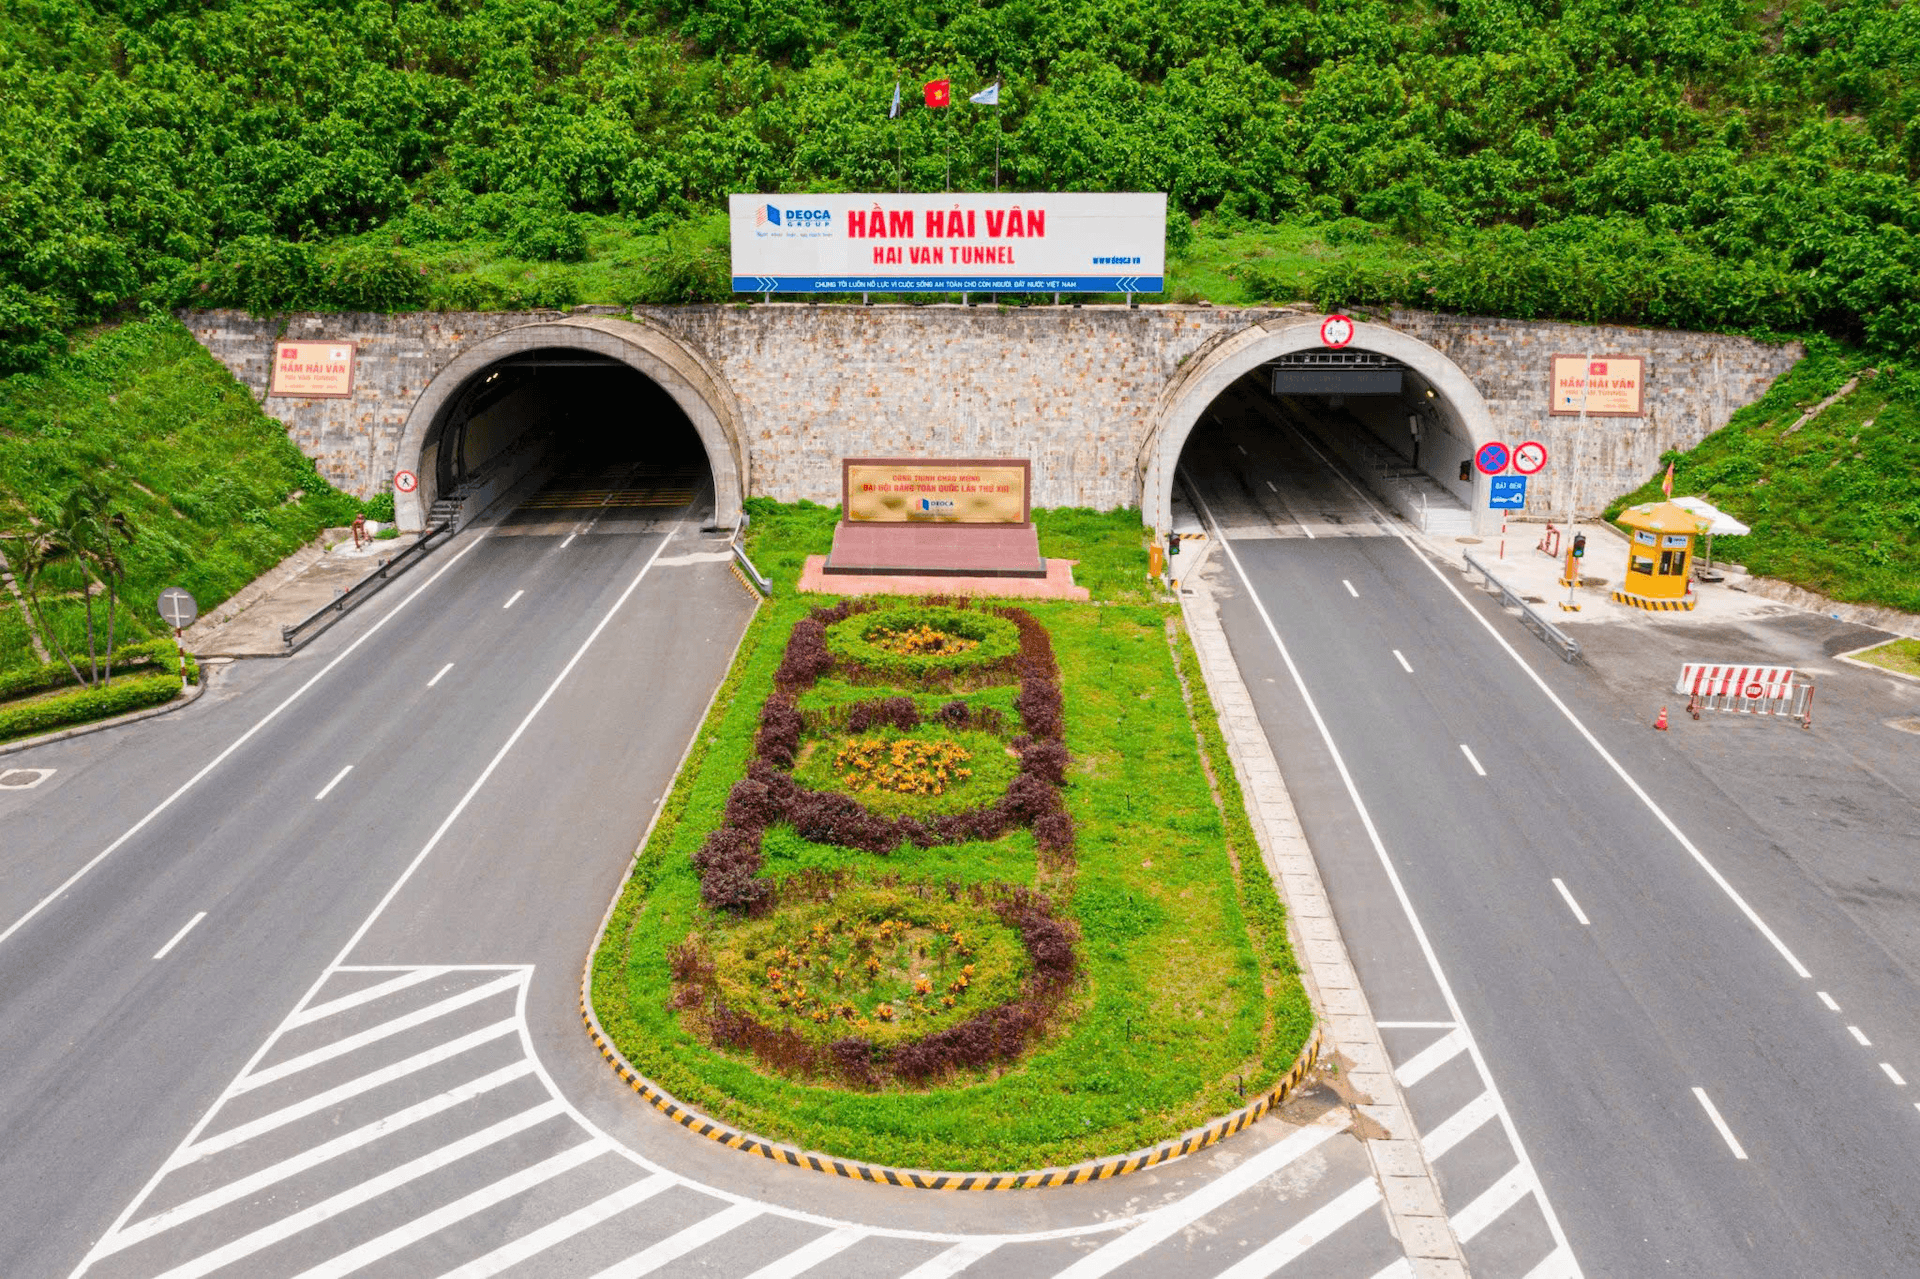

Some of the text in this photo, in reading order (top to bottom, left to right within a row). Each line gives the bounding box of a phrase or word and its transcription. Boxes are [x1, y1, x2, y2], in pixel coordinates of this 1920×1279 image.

[786, 210, 831, 220] DEOCA
[848, 202, 1045, 238] HẦM HẢI VÂN
[873, 246, 1015, 264] HAI VAN TUNNEL
